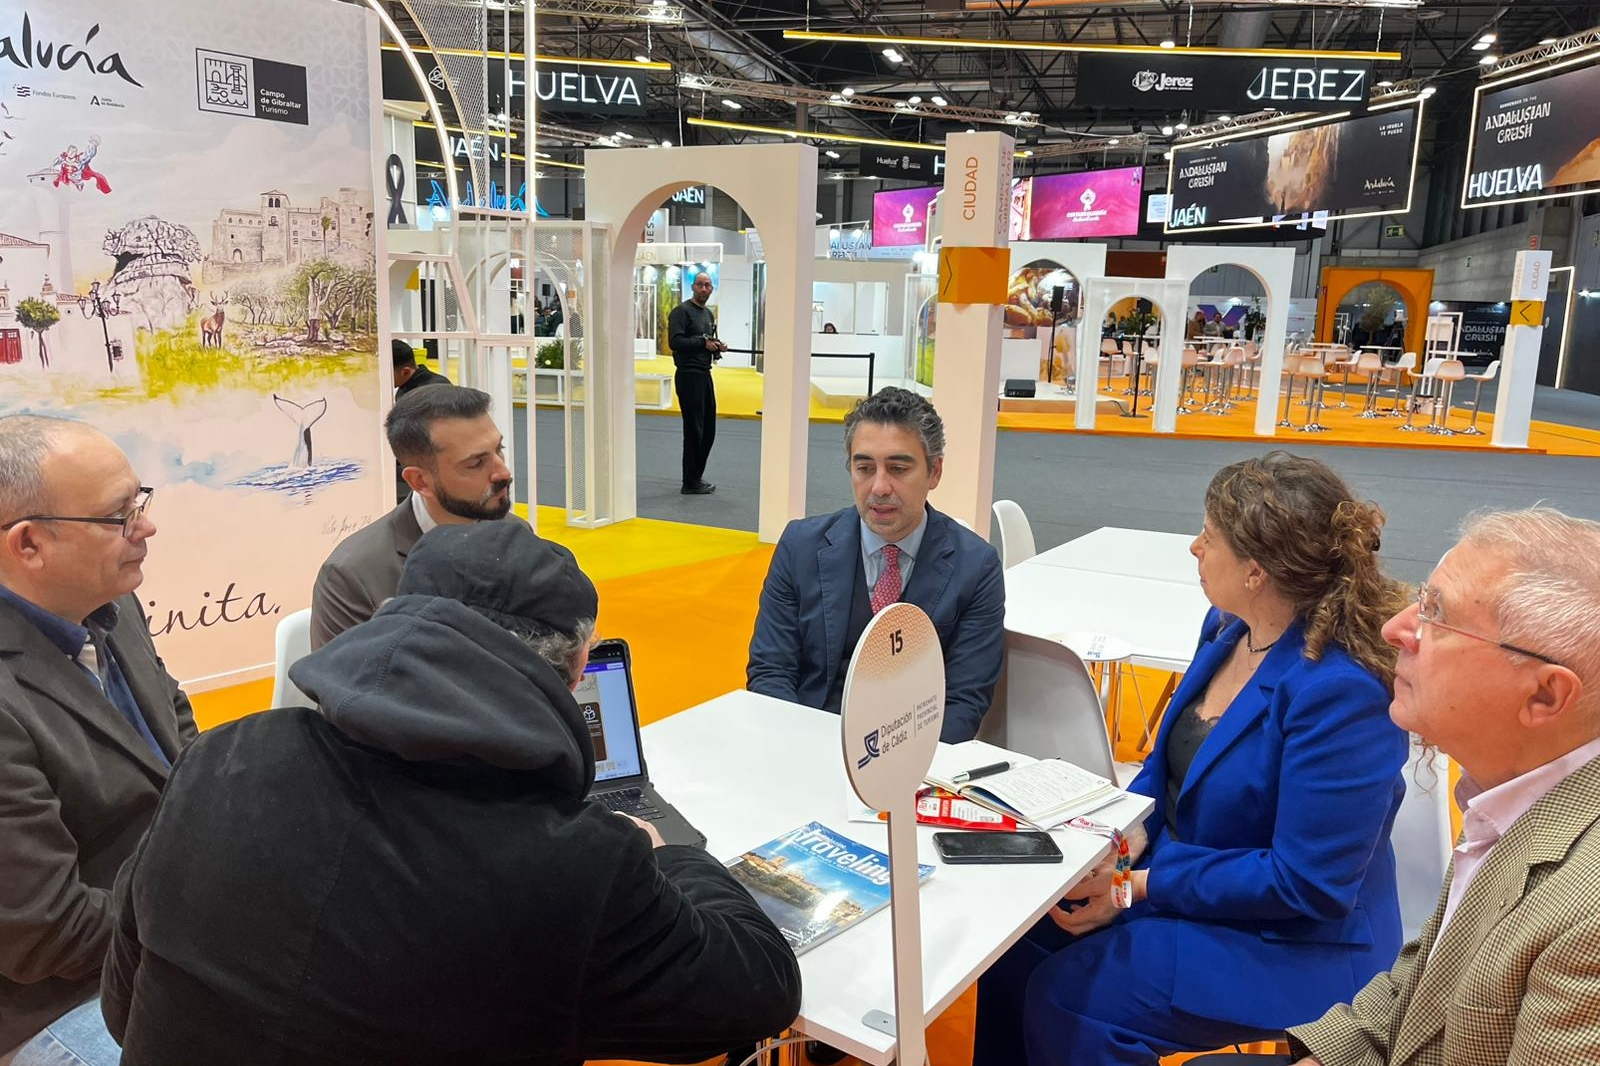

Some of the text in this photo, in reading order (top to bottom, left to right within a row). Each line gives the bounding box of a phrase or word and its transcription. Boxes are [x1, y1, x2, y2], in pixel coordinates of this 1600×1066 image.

[260, 88, 286, 100] Campo
[509, 69, 641, 106] HUELVA
[1155, 73, 1193, 91] Jerez
[1247, 67, 1366, 101] JEREZ
[261, 105, 289, 115] Turismo
[271, 99, 302, 109] Gibraltar
[963, 157, 978, 221] CIUDAD
[1468, 163, 1543, 199] HUELVA
[1169, 203, 1207, 228] JAÉN
[889, 629, 904, 656] 15
[881, 711, 912, 738] Diputación
[882, 730, 908, 754] de Cádiz
